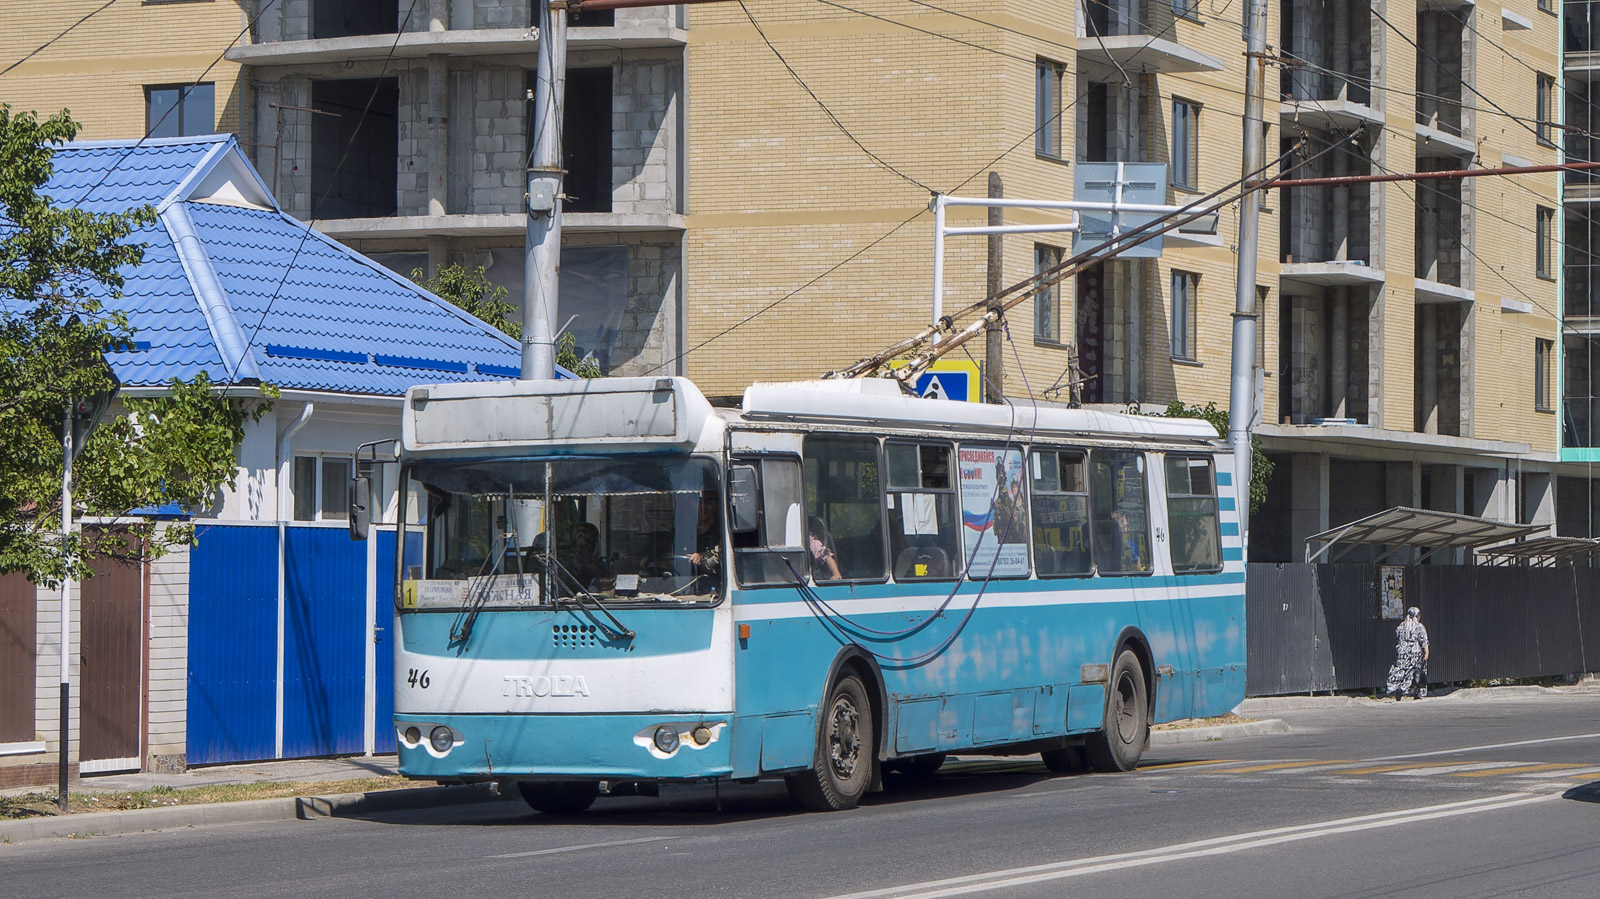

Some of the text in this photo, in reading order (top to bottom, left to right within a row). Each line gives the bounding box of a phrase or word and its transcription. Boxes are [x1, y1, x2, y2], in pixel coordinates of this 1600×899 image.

[1156, 527, 1165, 543] 46
[406, 587, 413, 606] 1
[407, 667, 431, 689] 46
